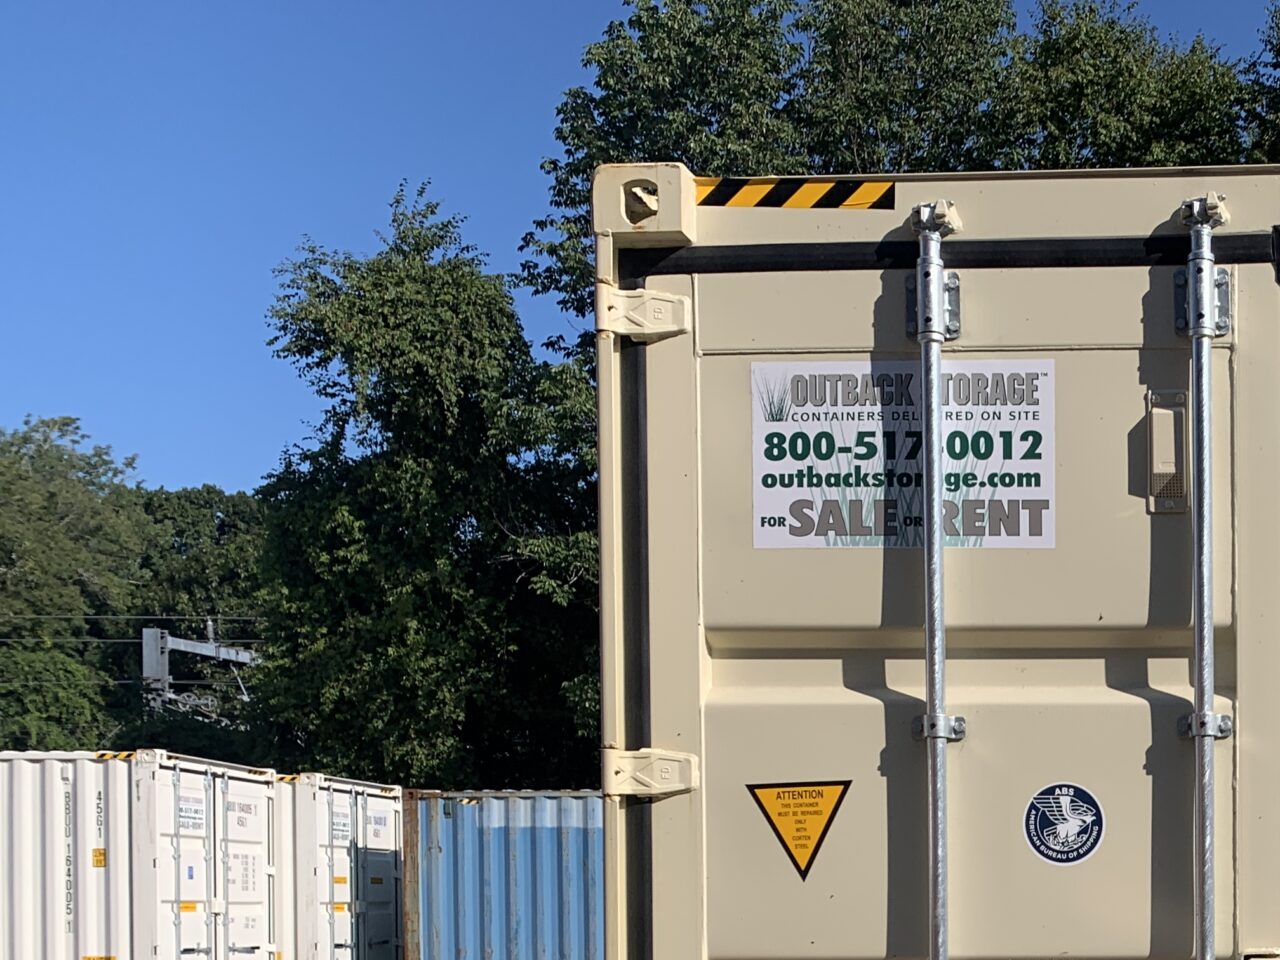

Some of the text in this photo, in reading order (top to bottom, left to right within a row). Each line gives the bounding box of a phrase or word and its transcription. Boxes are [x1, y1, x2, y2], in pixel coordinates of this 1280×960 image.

[790, 372, 914, 407] OUTBACK
[920, 372, 1040, 406] TORAGE
[791, 410, 1041, 422] CONTAINERS DELRED ON SITE
[763, 430, 1043, 462] 800-5170012
[761, 465, 1042, 492] outbackstorge.com
[760, 516, 787, 528] FOR
[788, 498, 898, 538] SALE
[776, 789, 824, 800] ATTENTION
[1054, 787, 1075, 796] ABS
[1028, 809, 1041, 847] AMERICAN
[1039, 845, 1067, 859] BUREAU
[1078, 825, 1099, 855] SHIPPING
